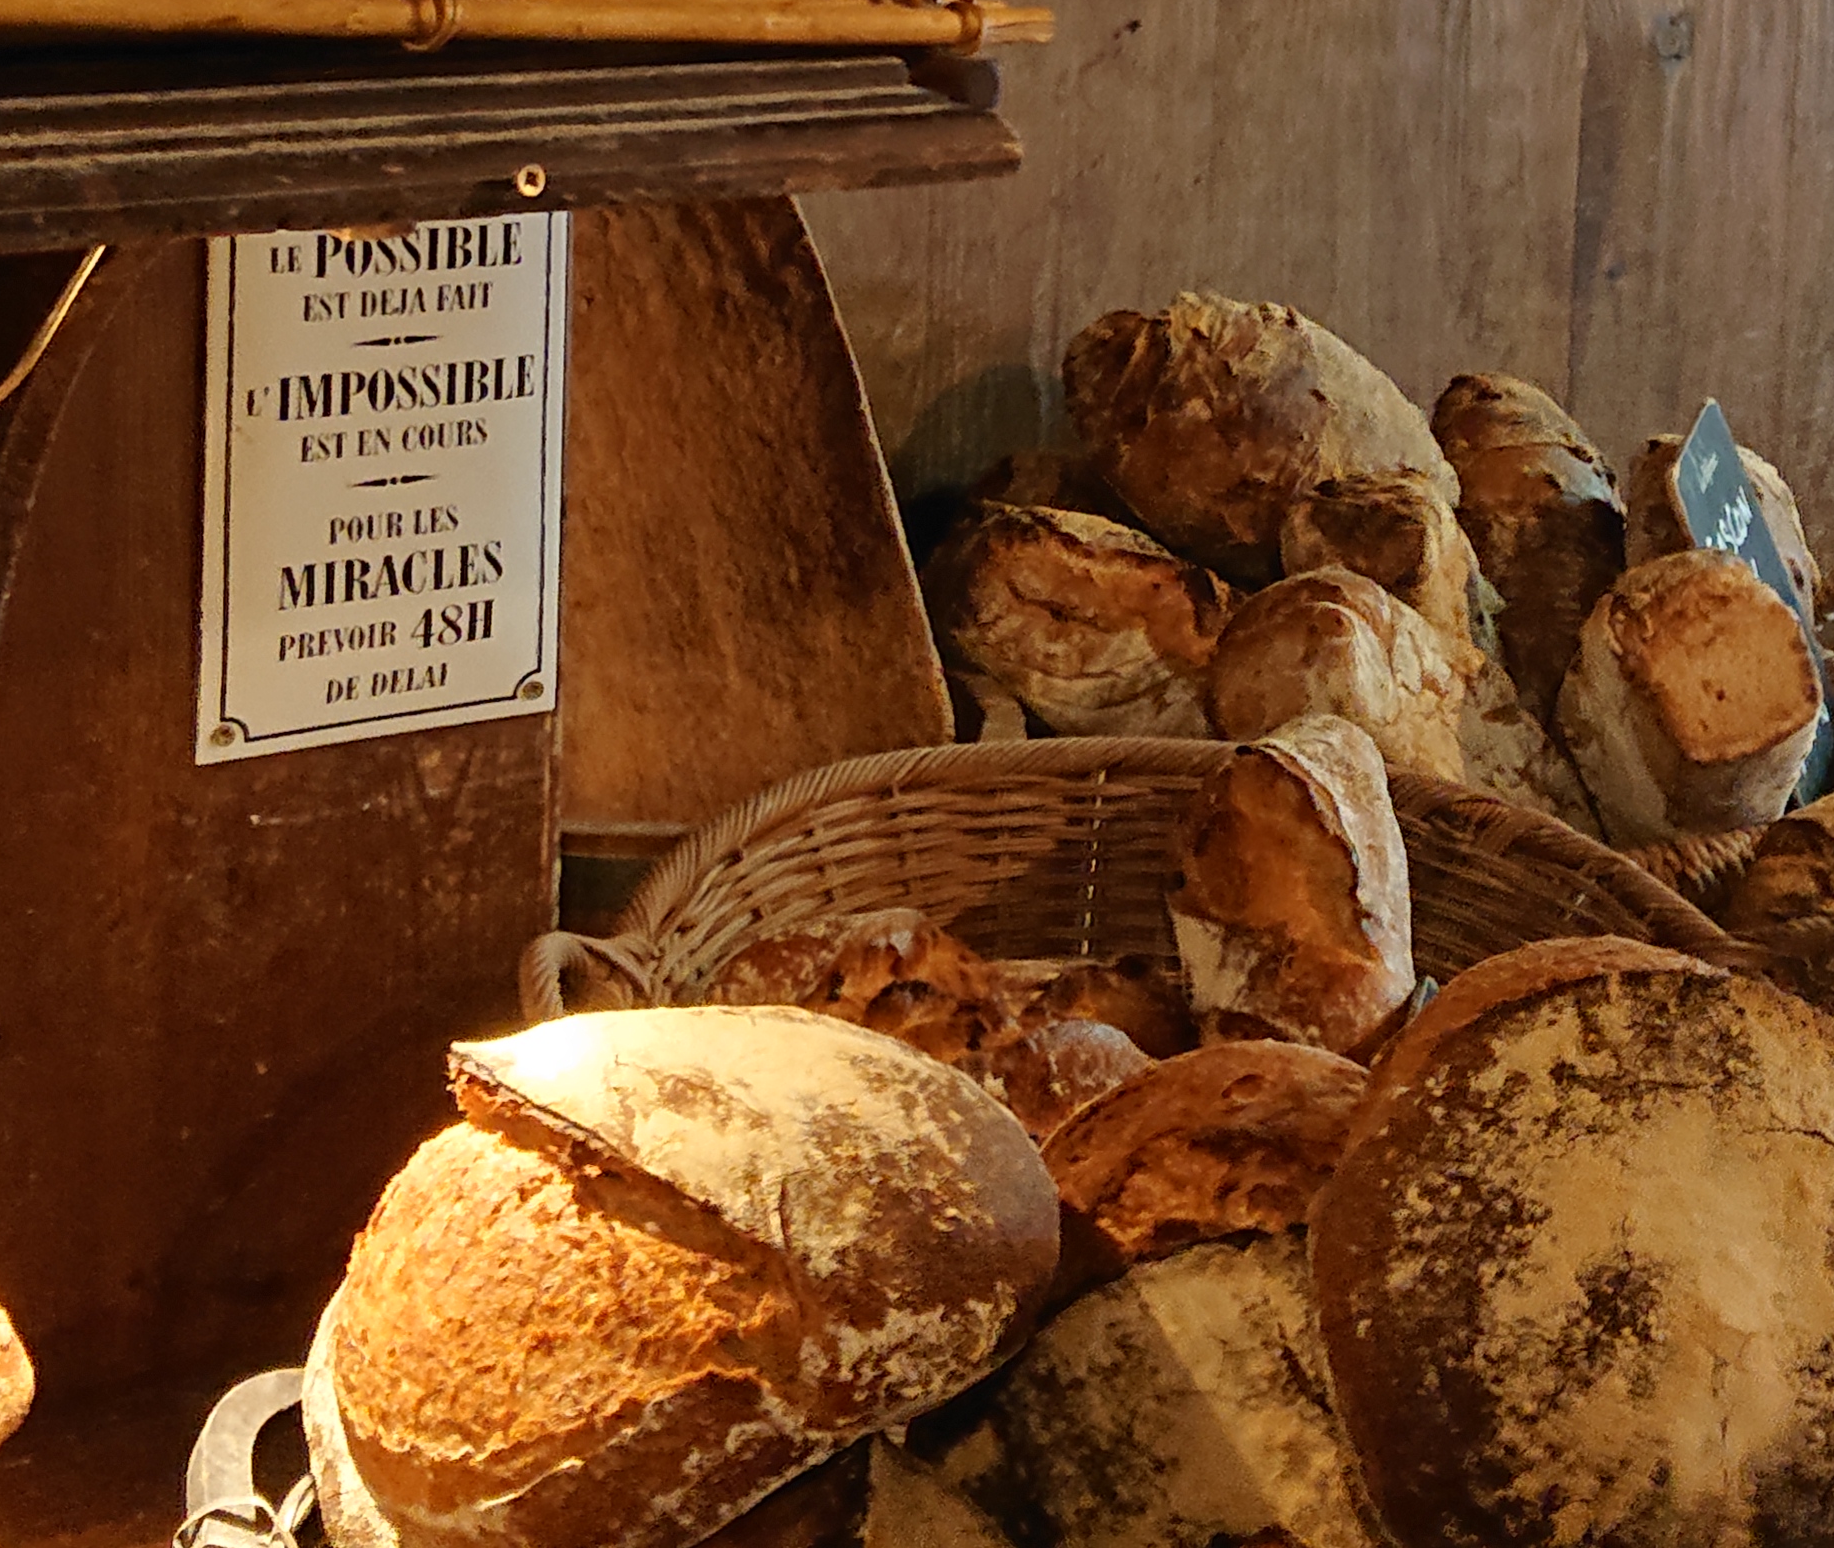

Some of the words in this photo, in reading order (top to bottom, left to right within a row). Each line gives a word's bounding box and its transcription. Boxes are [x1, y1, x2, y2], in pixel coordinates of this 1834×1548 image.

[268, 245, 303, 274] LE
[314, 221, 523, 279] POSSIBLE
[303, 291, 351, 322] EST
[360, 286, 427, 319] DEJA
[436, 281, 494, 313] FAIT
[246, 354, 536, 422] L'IMPOSSIBLE
[300, 430, 348, 463] EST
[357, 424, 392, 457] EN
[401, 417, 489, 452] COURS
[328, 511, 404, 545] POUR
[413, 504, 460, 535] LES
[277, 540, 504, 611] MIRACLES
[277, 620, 397, 663] PREVOIR
[410, 598, 495, 650] 48H
[325, 675, 360, 705] DE
[370, 662, 449, 698] DELAI
